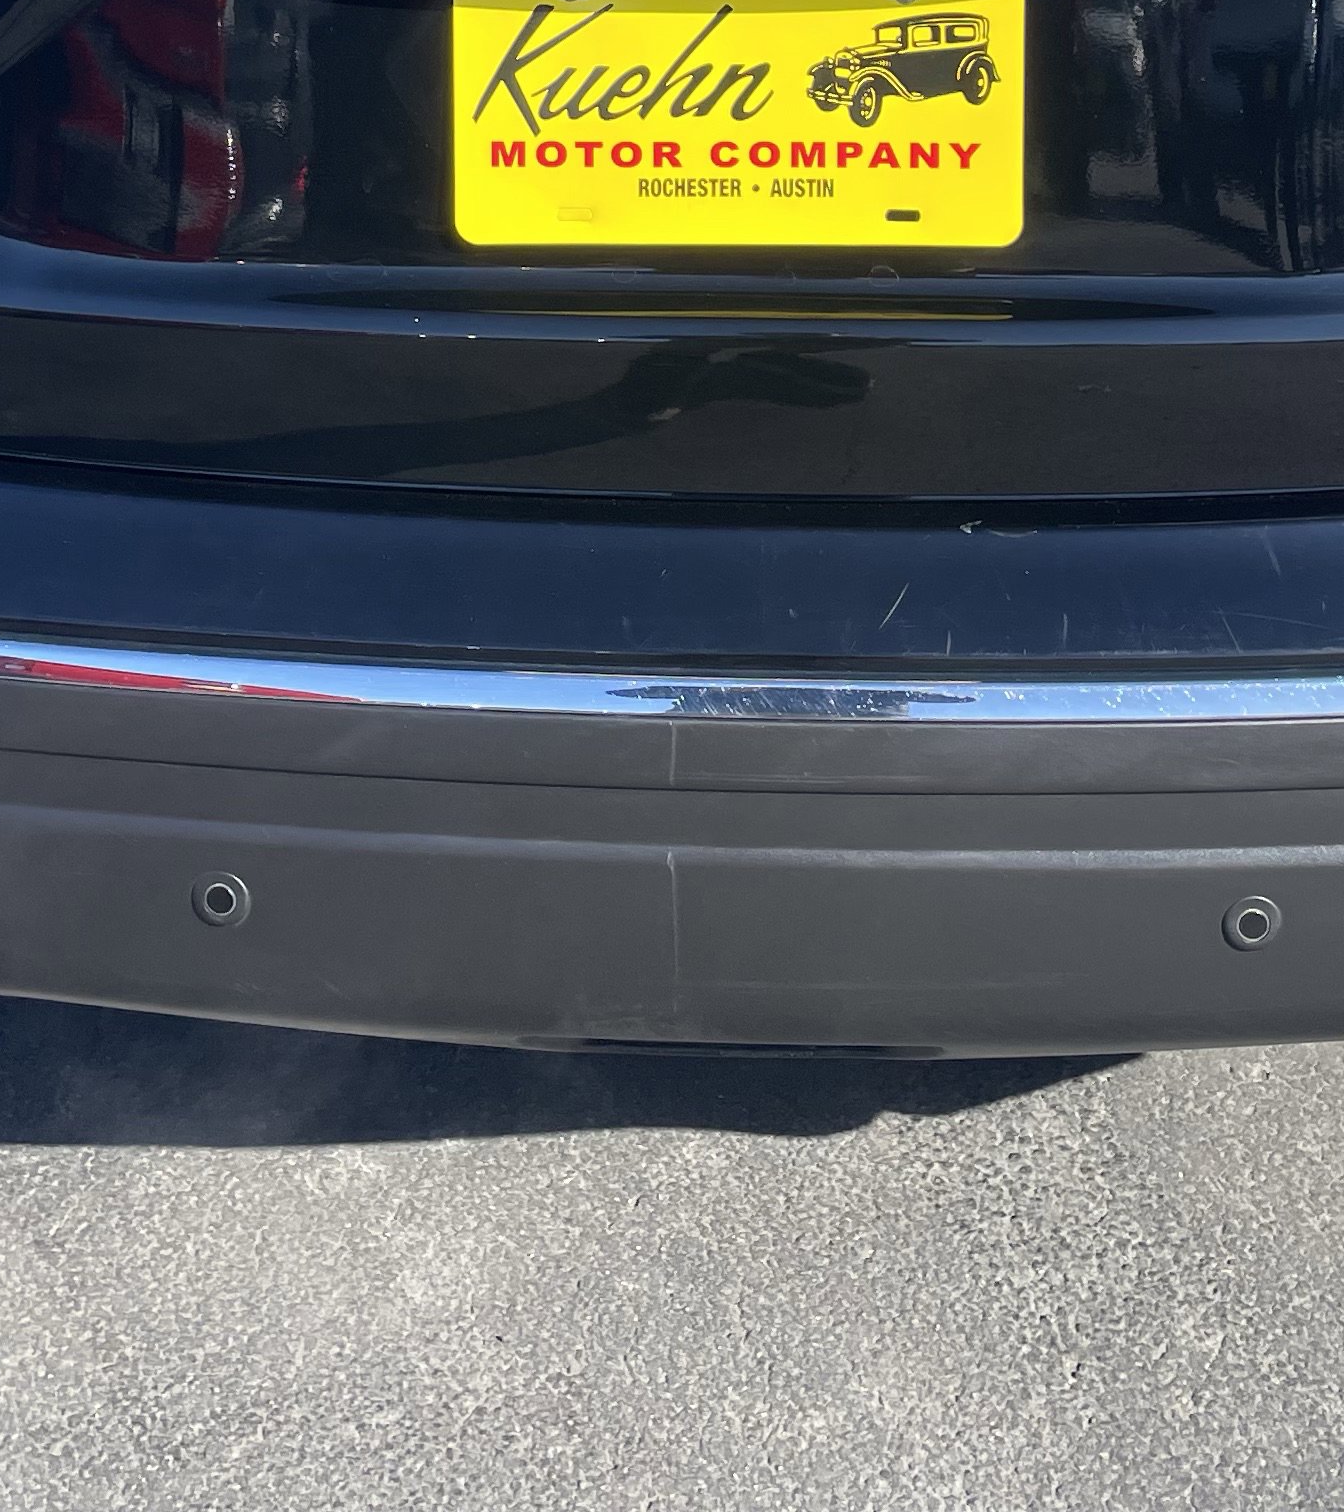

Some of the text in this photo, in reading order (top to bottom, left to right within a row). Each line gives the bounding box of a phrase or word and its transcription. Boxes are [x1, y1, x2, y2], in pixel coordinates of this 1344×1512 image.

[472, 2, 774, 137] Kuehn
[490, 141, 982, 170] MOTOR COMPANY
[638, 178, 835, 199] ROCHESTER AUSTIN
